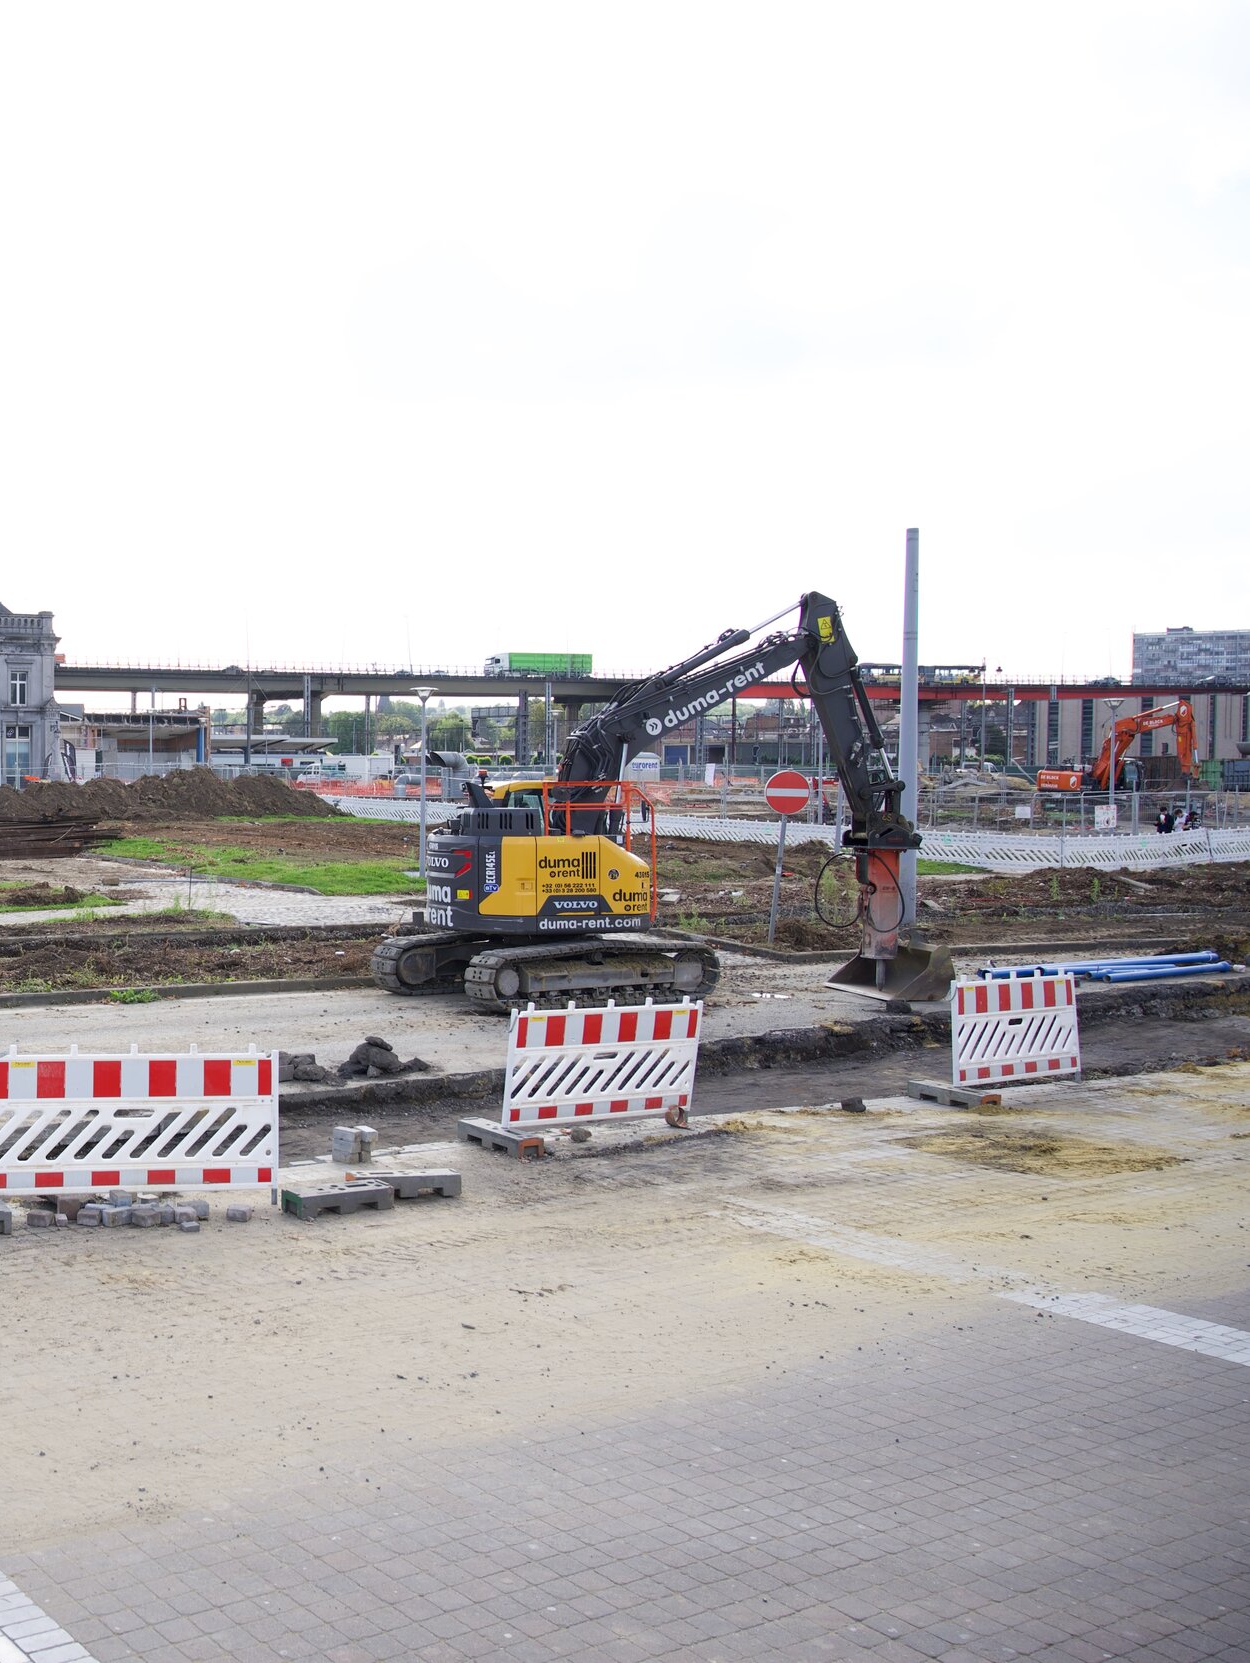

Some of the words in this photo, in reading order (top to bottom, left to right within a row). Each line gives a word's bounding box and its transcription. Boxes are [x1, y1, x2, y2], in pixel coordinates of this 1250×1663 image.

[664, 661, 765, 728] duma-rent
[427, 855, 449, 868] OLVO
[538, 856, 581, 869] duma
[557, 868, 581, 878] rent
[612, 889, 648, 902] duma
[553, 901, 598, 909] VOLVO
[632, 903, 648, 912] rent
[539, 917, 641, 930] duma-rent.com
